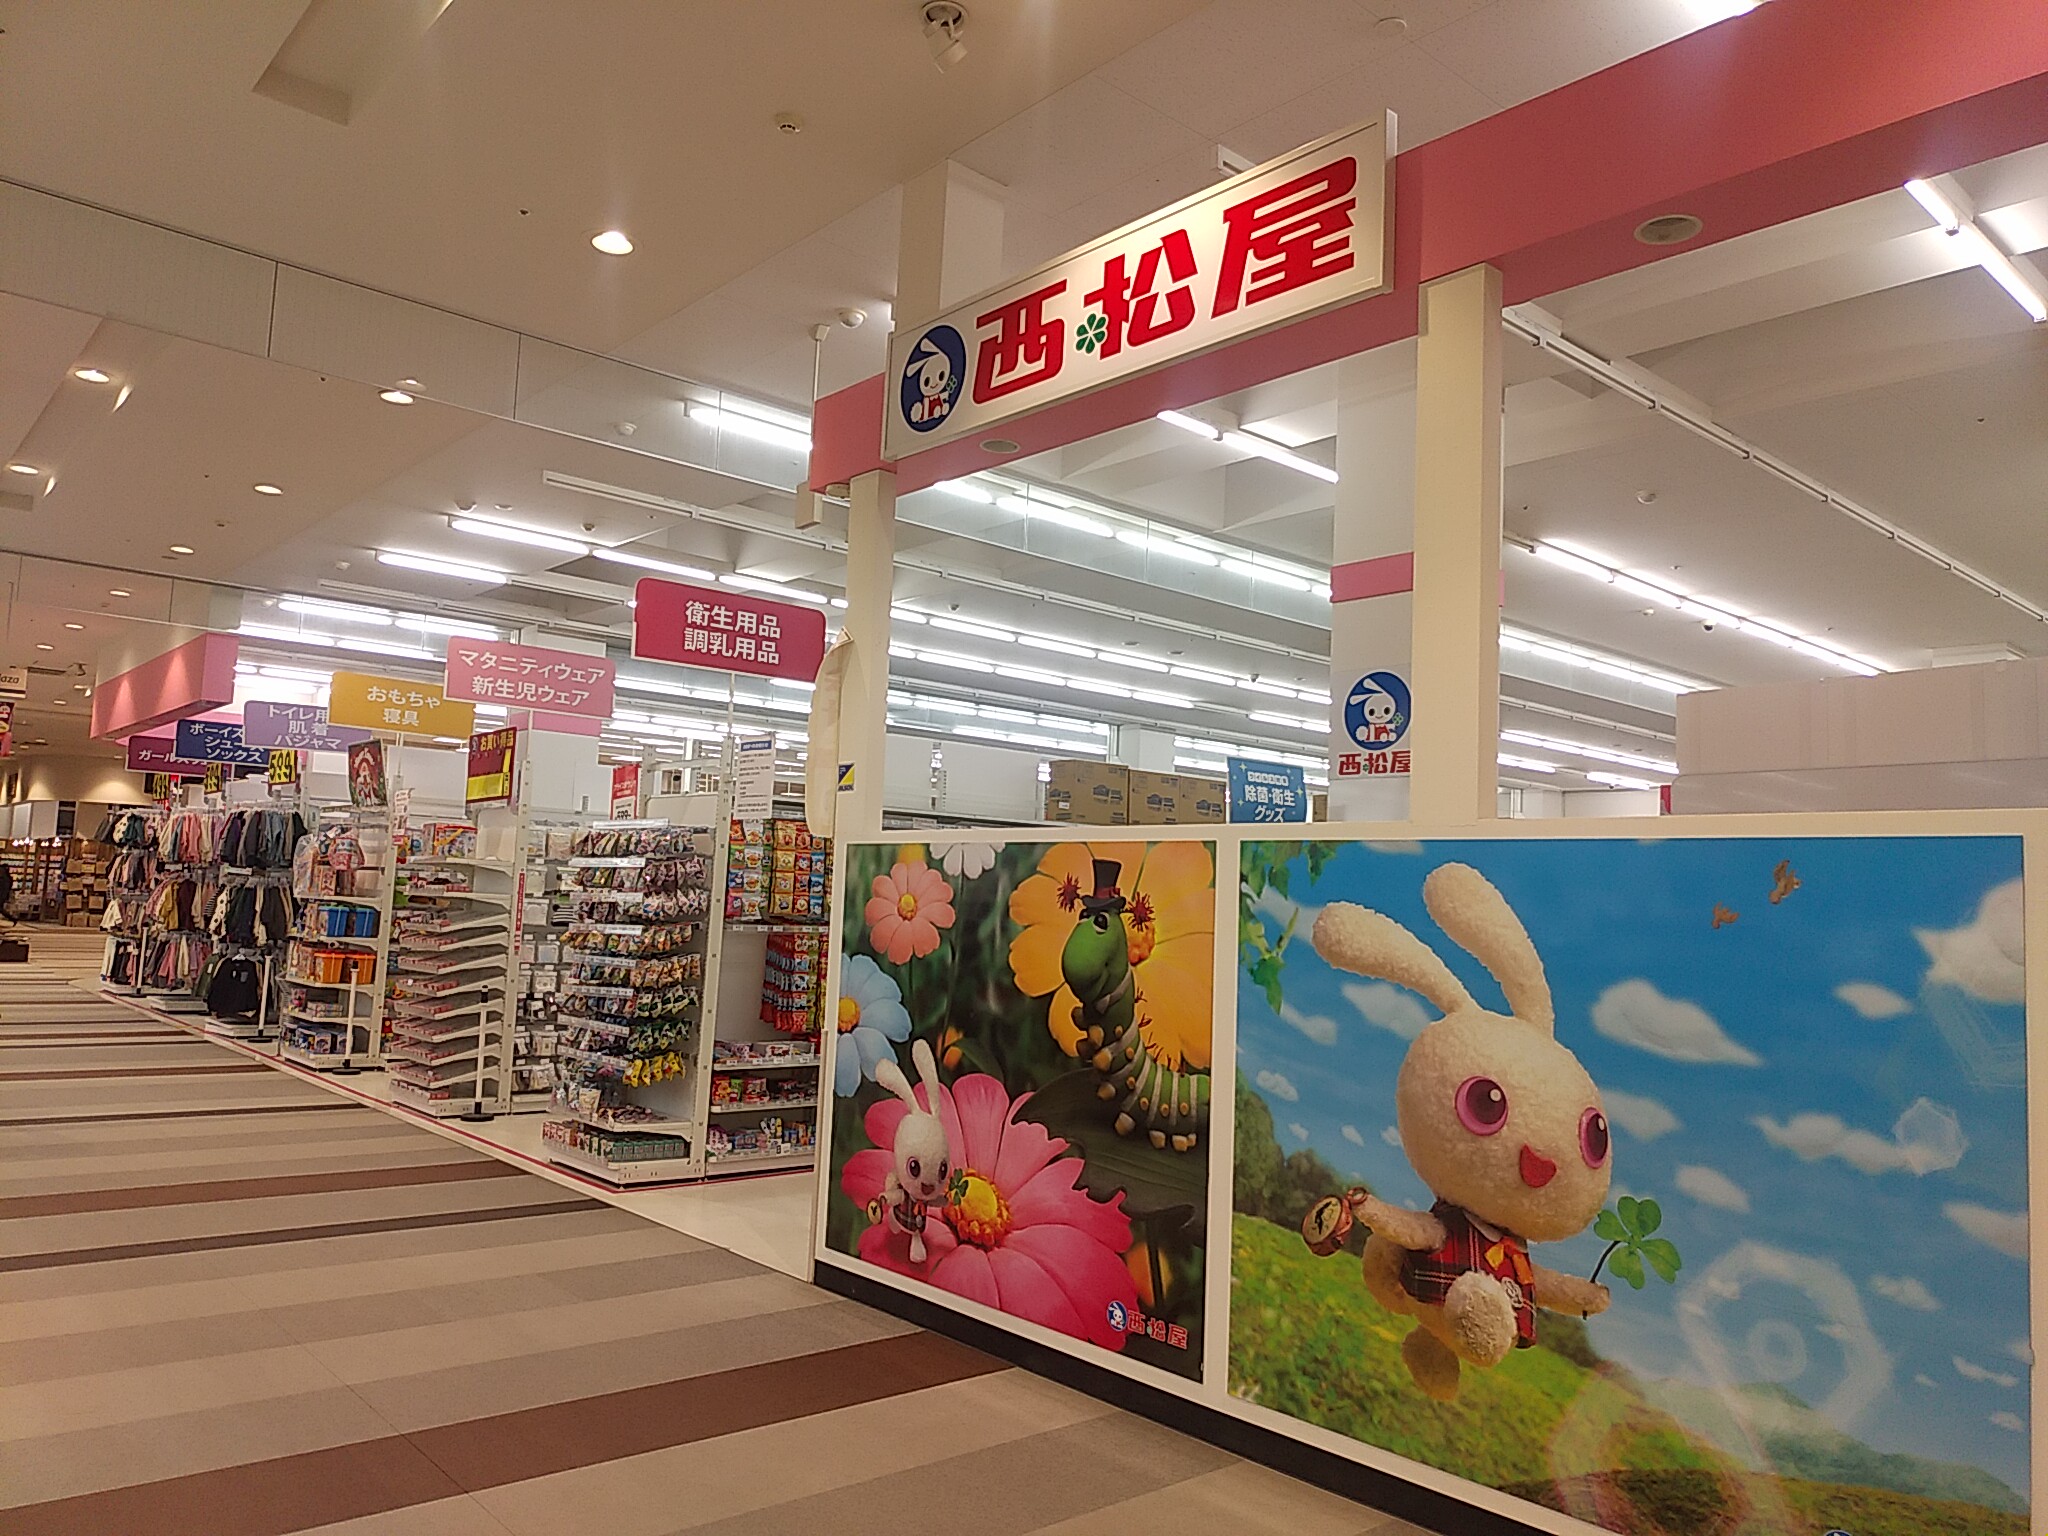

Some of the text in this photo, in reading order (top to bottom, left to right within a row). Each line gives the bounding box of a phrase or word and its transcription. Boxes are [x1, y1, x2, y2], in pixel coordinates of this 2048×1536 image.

[972, 156, 1357, 405] 西松屋
[685, 600, 781, 639] 衛生用品
[683, 627, 780, 665] 調乳用品
[458, 649, 606, 684] マタニティウェア
[0, 674, 20, 684] aza
[471, 675, 590, 706] 新生児ウェア
[367, 686, 441, 709] おもちゃ
[269, 704, 327, 721] トイレ用
[383, 708, 420, 727] 寝具
[274, 734, 341, 749] パジャマ
[205, 748, 262, 763] ソックス
[1338, 750, 1411, 776] 西松屋
[1244, 784, 1296, 807] 除菌・衛生
[1254, 804, 1286, 823] グッズ
[1127, 1310, 1188, 1350] 西松屋
